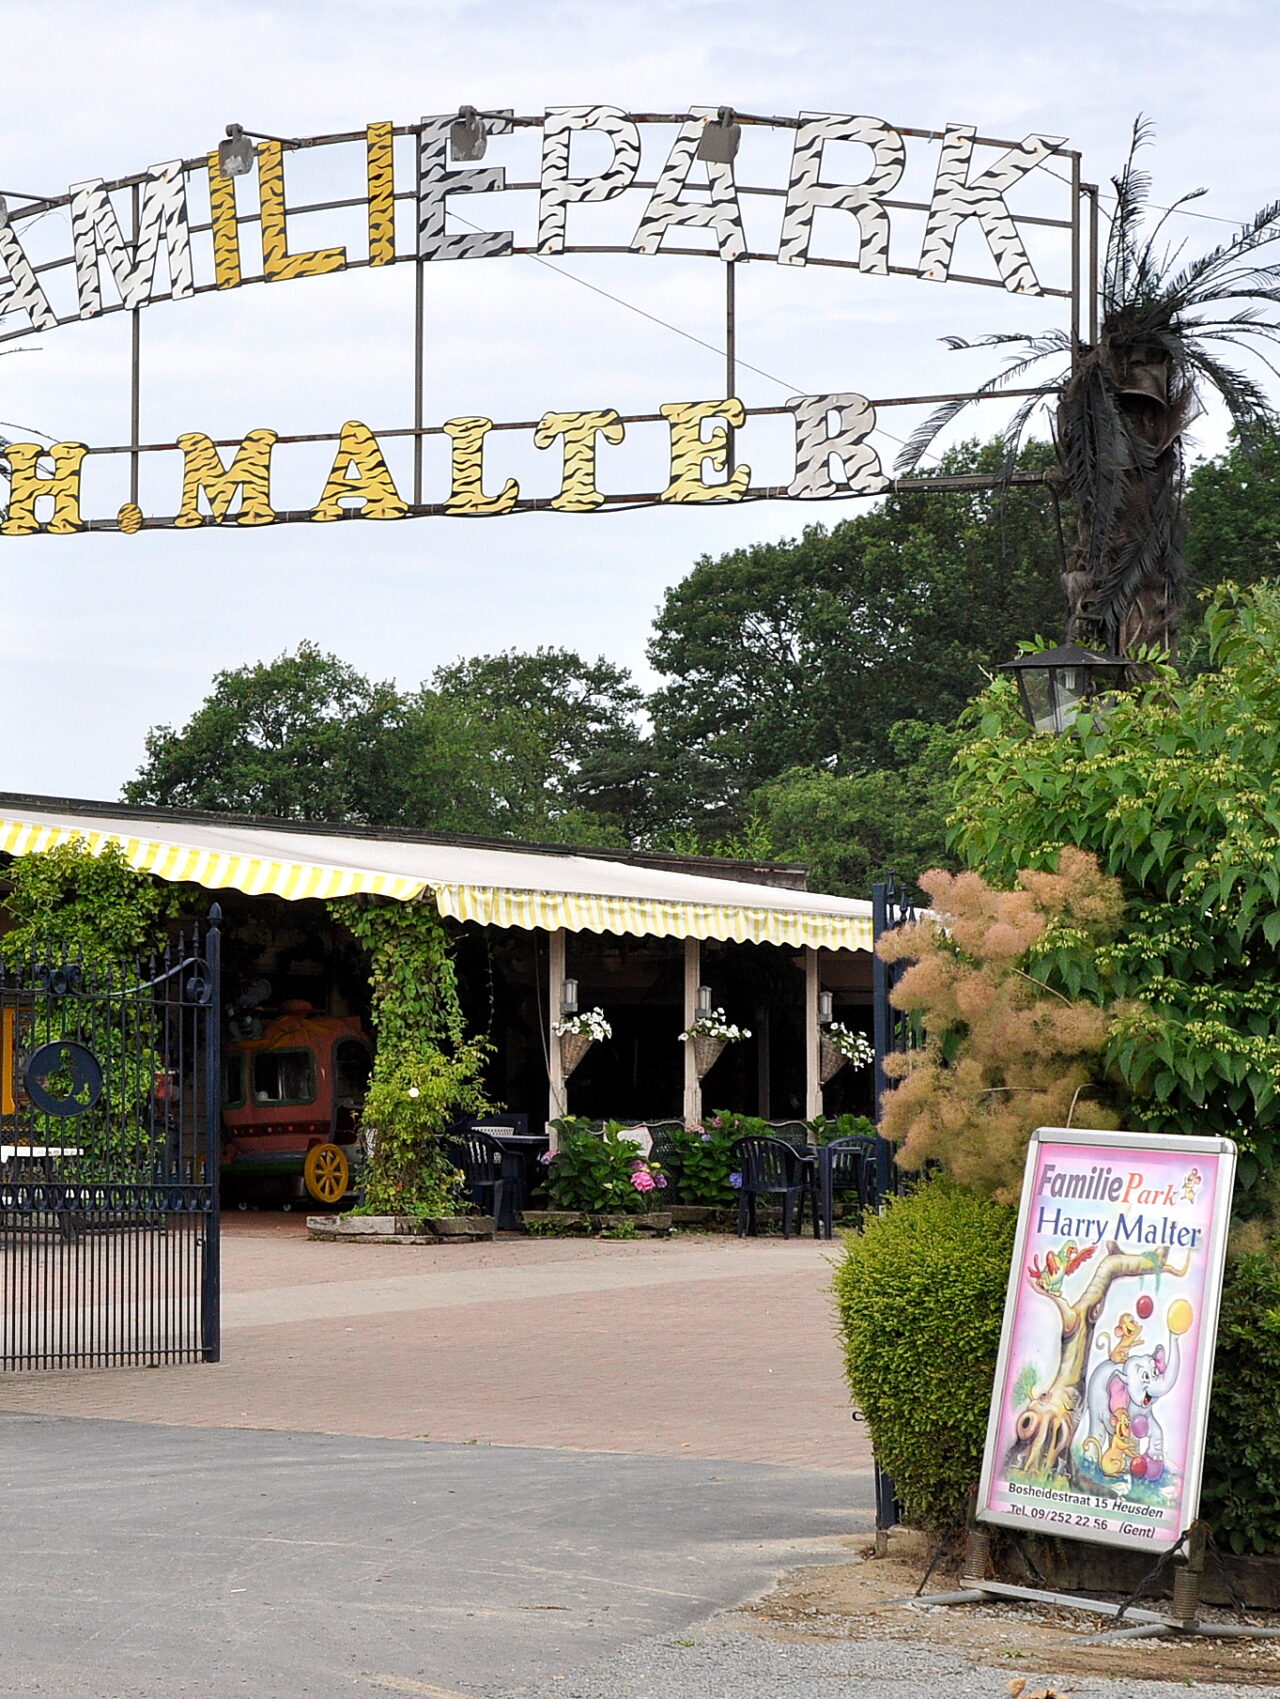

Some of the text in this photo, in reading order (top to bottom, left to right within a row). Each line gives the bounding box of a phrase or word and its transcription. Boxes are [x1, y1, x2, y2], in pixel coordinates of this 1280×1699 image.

[1037, 1206, 1201, 1247] Harry Malter
[1008, 1482, 1164, 1518] Bosheidestraat 15 Heusden
[1031, 1507, 1072, 1525] 09/252
[1075, 1515, 1090, 1528] 22
[1093, 1519, 1108, 1531] 56
[1118, 1522, 1156, 1539] (Gent)
